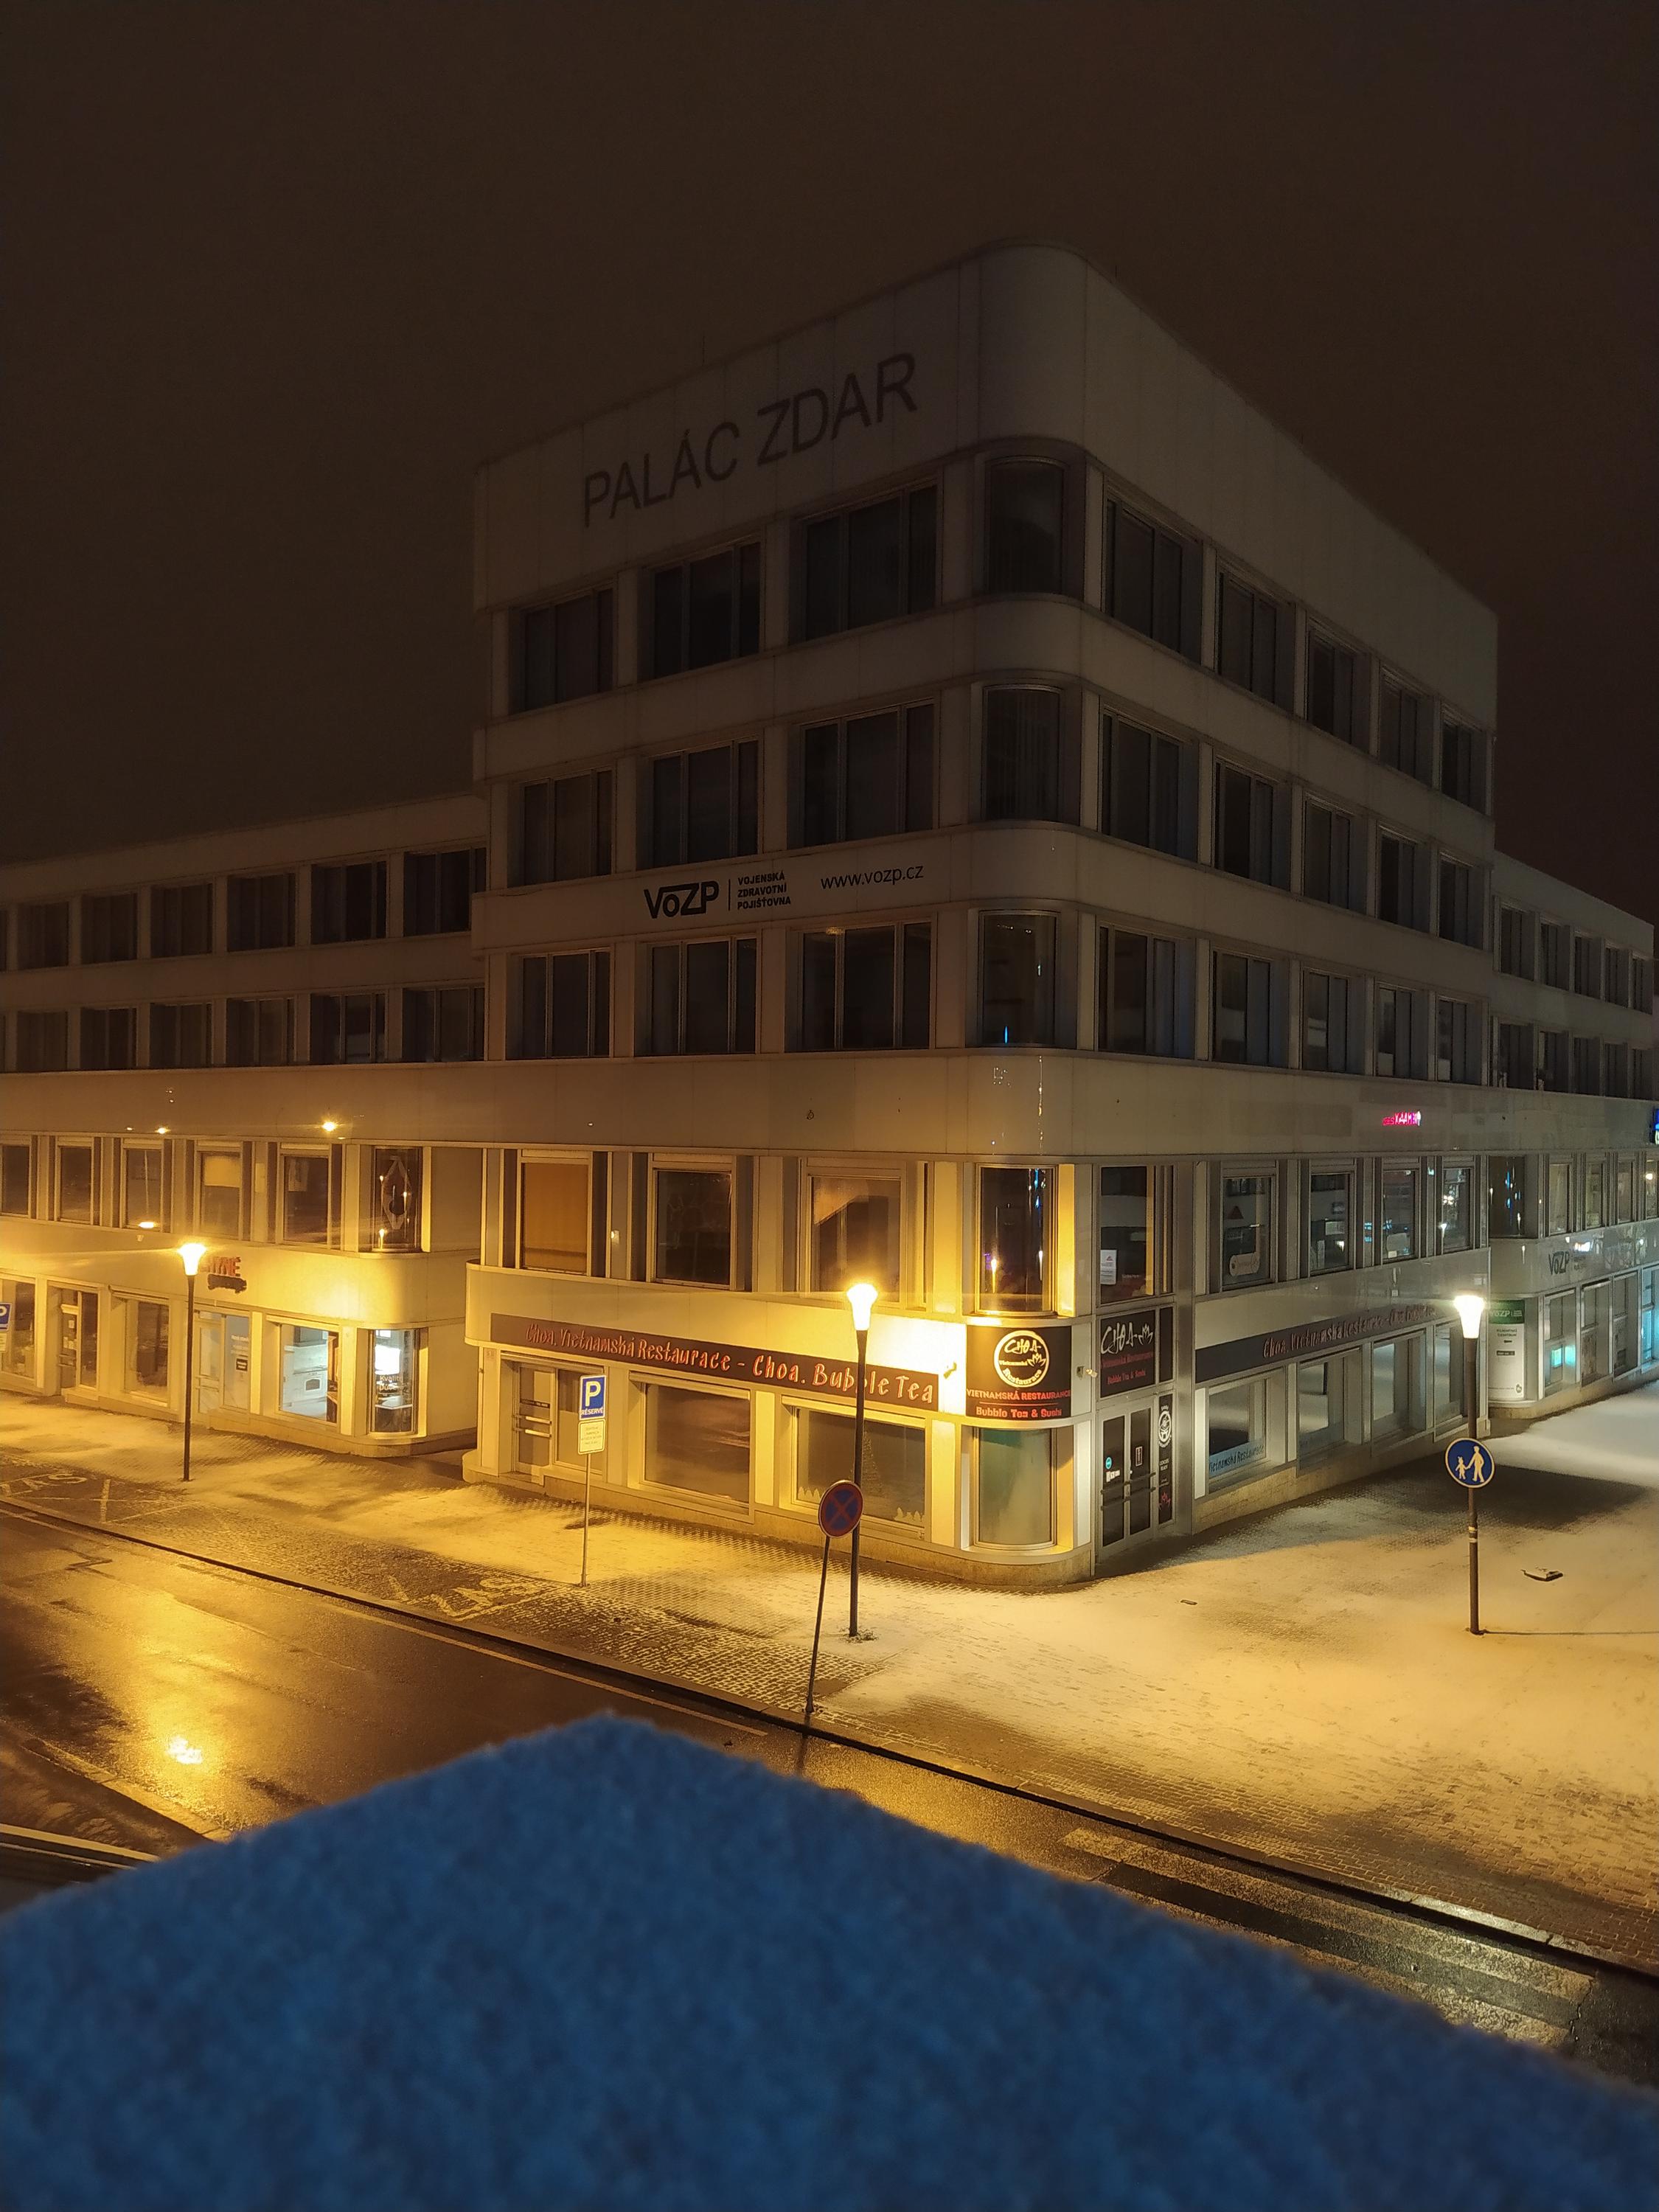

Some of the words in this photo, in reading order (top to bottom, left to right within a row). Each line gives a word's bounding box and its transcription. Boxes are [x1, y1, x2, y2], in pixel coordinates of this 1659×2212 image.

[584, 421, 740, 528] PALÁC
[757, 352, 917, 467] ZDAR
[737, 871, 785, 885] VOJENSKÁ
[821, 865, 924, 889] www.vozp.cz
[737, 883, 787, 897] ZDRAVOTNÍ
[737, 896, 791, 910] POJIŠŤOVNA
[1004, 1339, 1041, 1354] CHOA
[560, 1328, 635, 1357] Vietnamská
[637, 1338, 731, 1371] Restaurace
[752, 1354, 805, 1384] Choa.
[813, 1363, 889, 1396] Buble
[896, 1375, 933, 1404] Tea
[585, 1381, 601, 1407] P
[967, 1388, 1020, 1400] VIETNAMSKÁ
[976, 1407, 1007, 1417] Bubble
[1011, 1409, 1028, 1418] Tea
[1031, 1409, 1038, 1417] &
